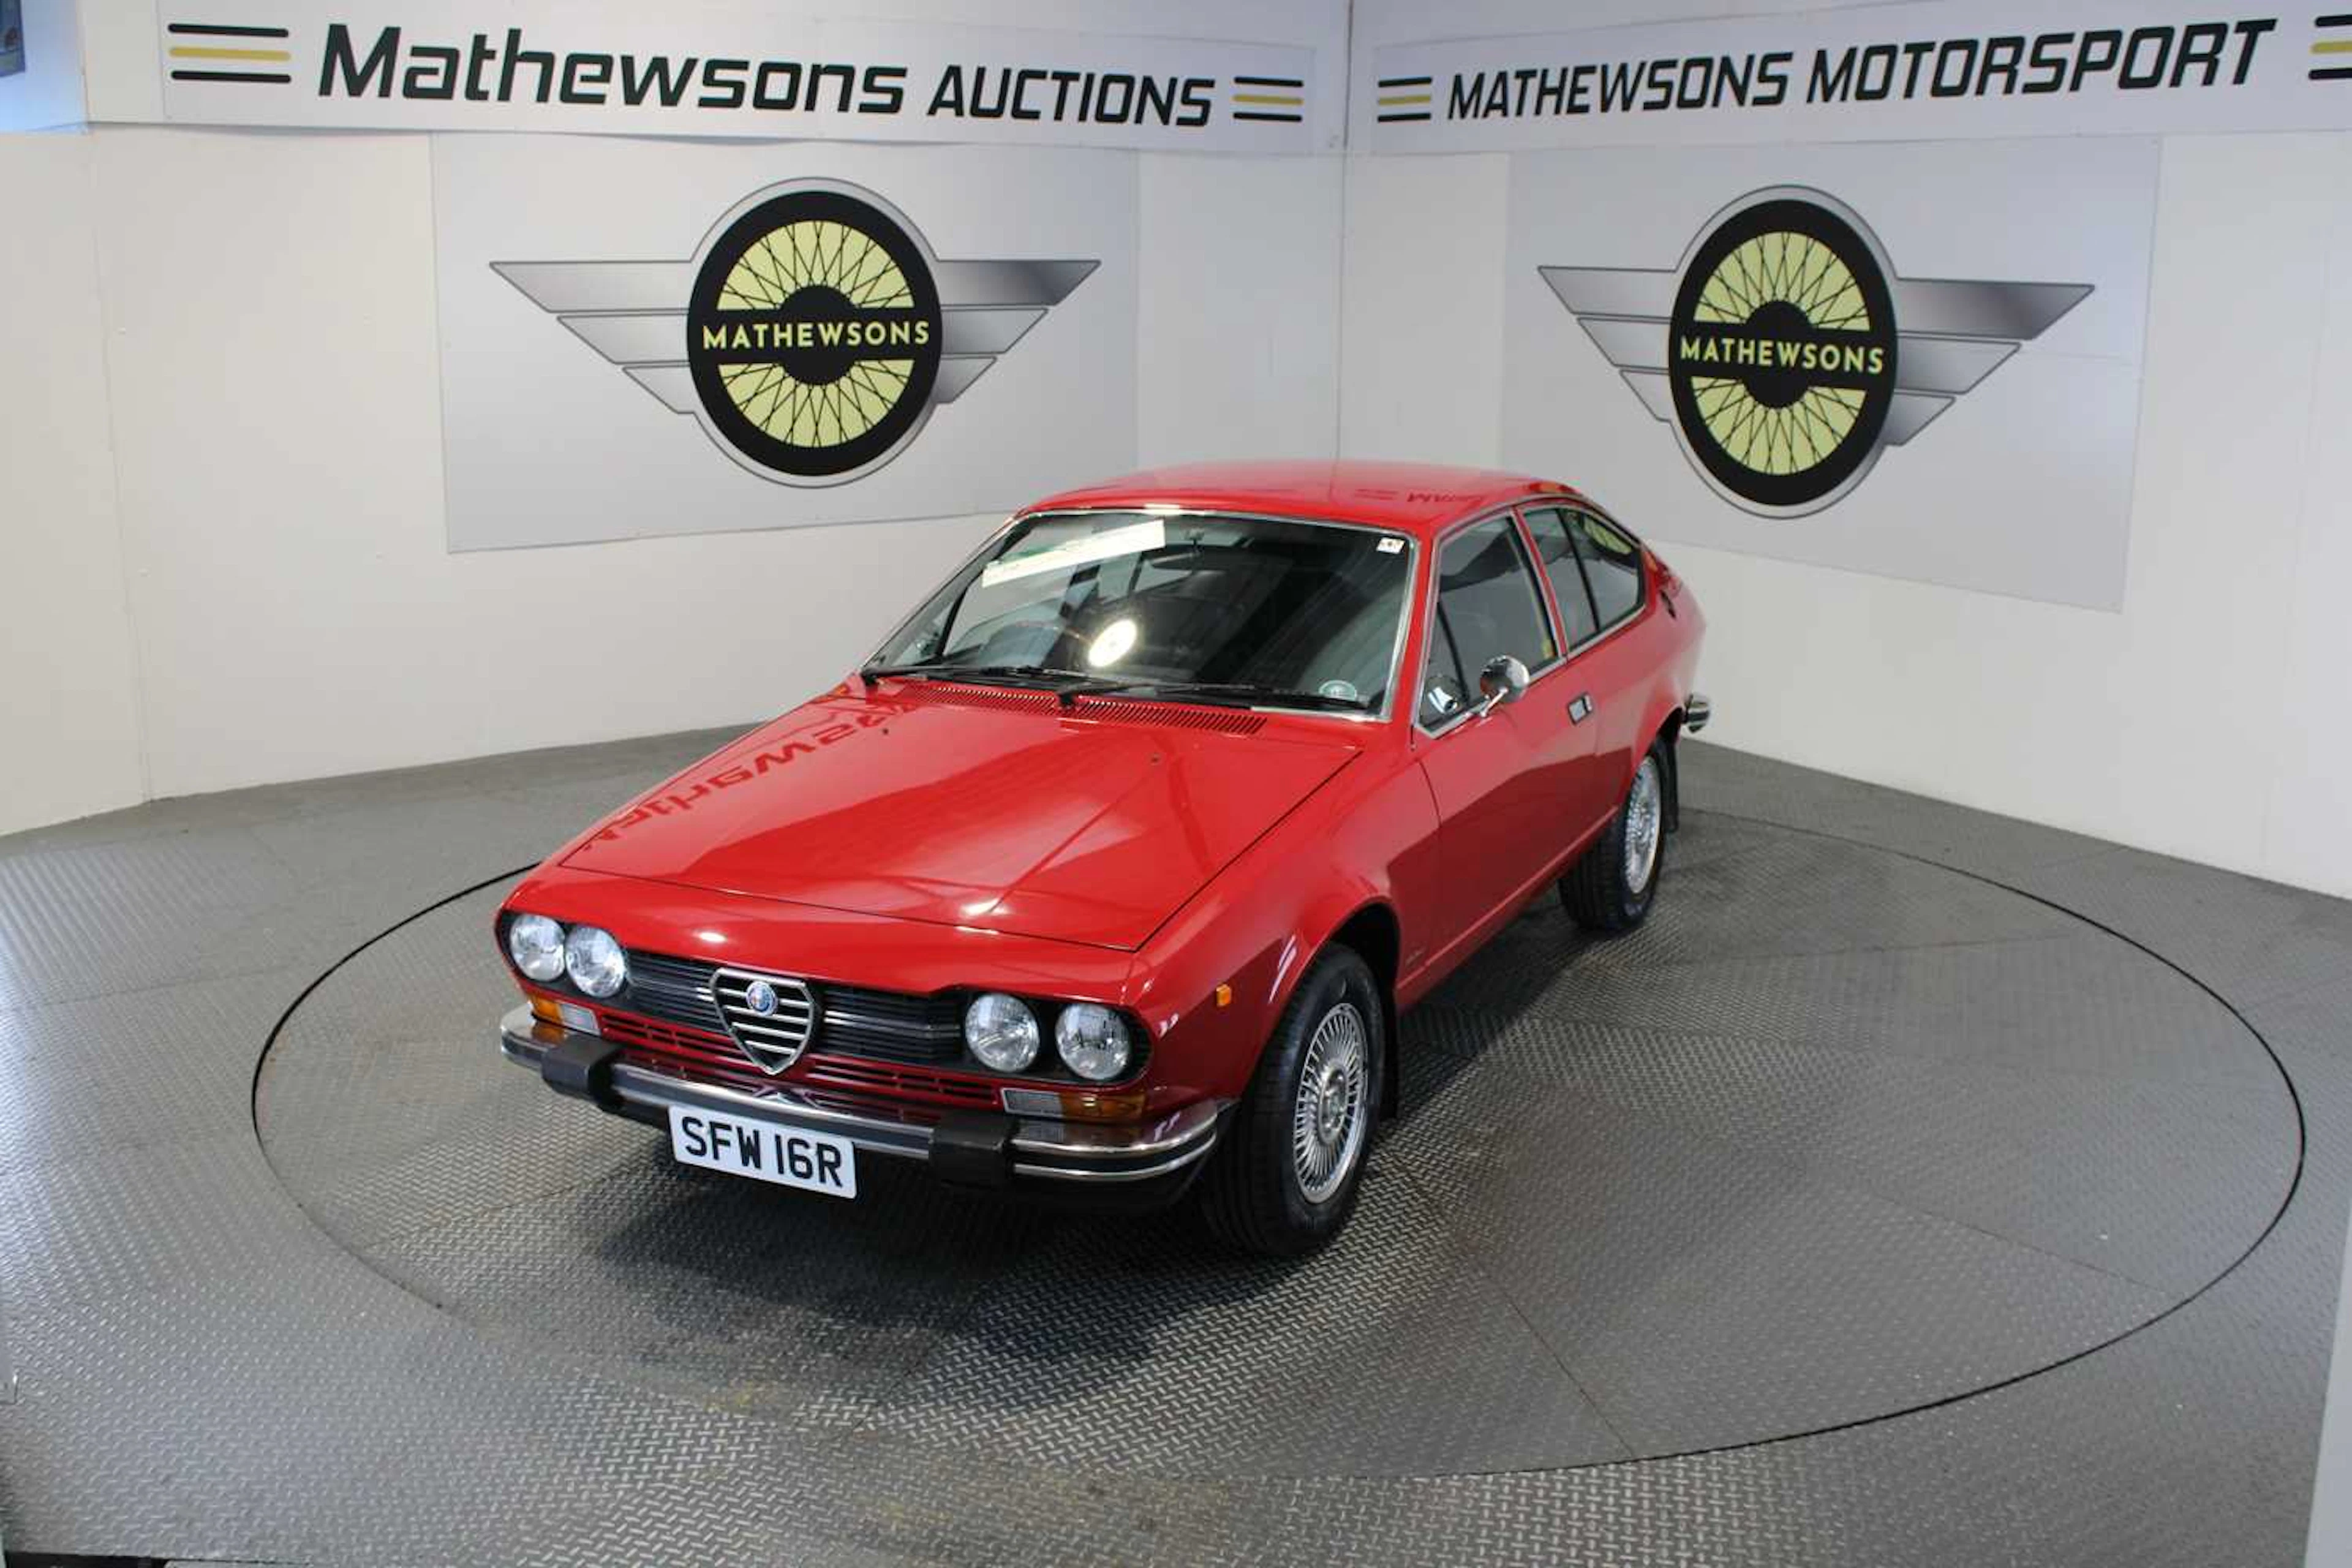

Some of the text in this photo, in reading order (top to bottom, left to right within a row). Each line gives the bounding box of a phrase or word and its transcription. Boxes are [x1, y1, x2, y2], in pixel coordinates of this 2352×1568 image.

[318, 23, 1216, 128] Mathewsons AUCTIONS
[1446, 17, 2278, 121] MATHEWSONS MOTORSPORT
[703, 320, 930, 350] MATHEWSONS
[1680, 336, 1885, 375] MATHEWSONS
[681, 1115, 843, 1188] SFW 16R
